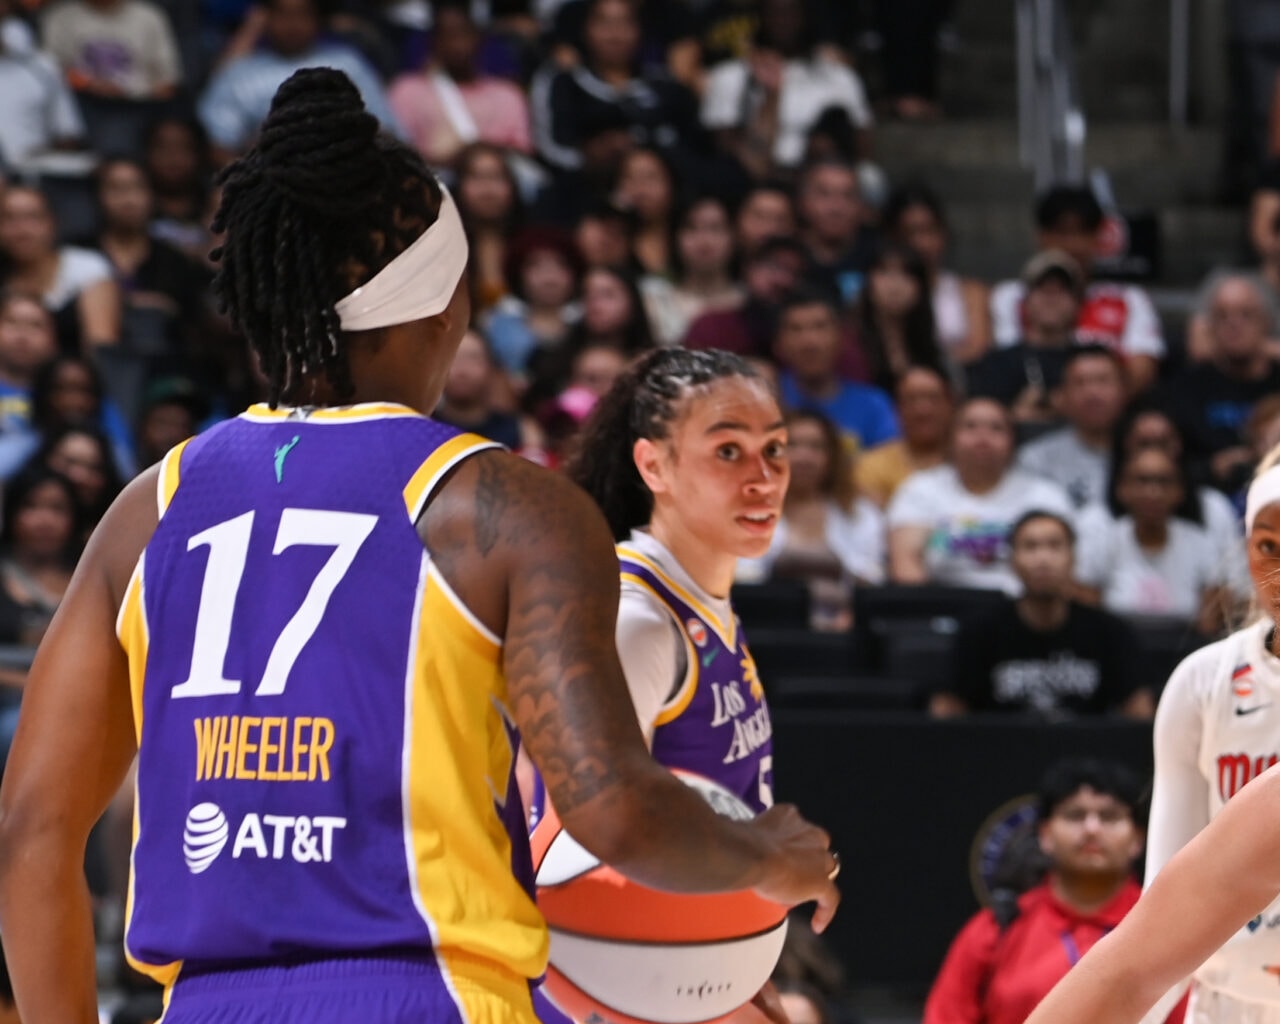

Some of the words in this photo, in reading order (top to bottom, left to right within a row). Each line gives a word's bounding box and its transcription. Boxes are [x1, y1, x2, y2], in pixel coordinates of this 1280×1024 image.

[171, 508, 379, 698] 17
[194, 715, 335, 782] WHEELER
[232, 813, 347, 863] AT&T
